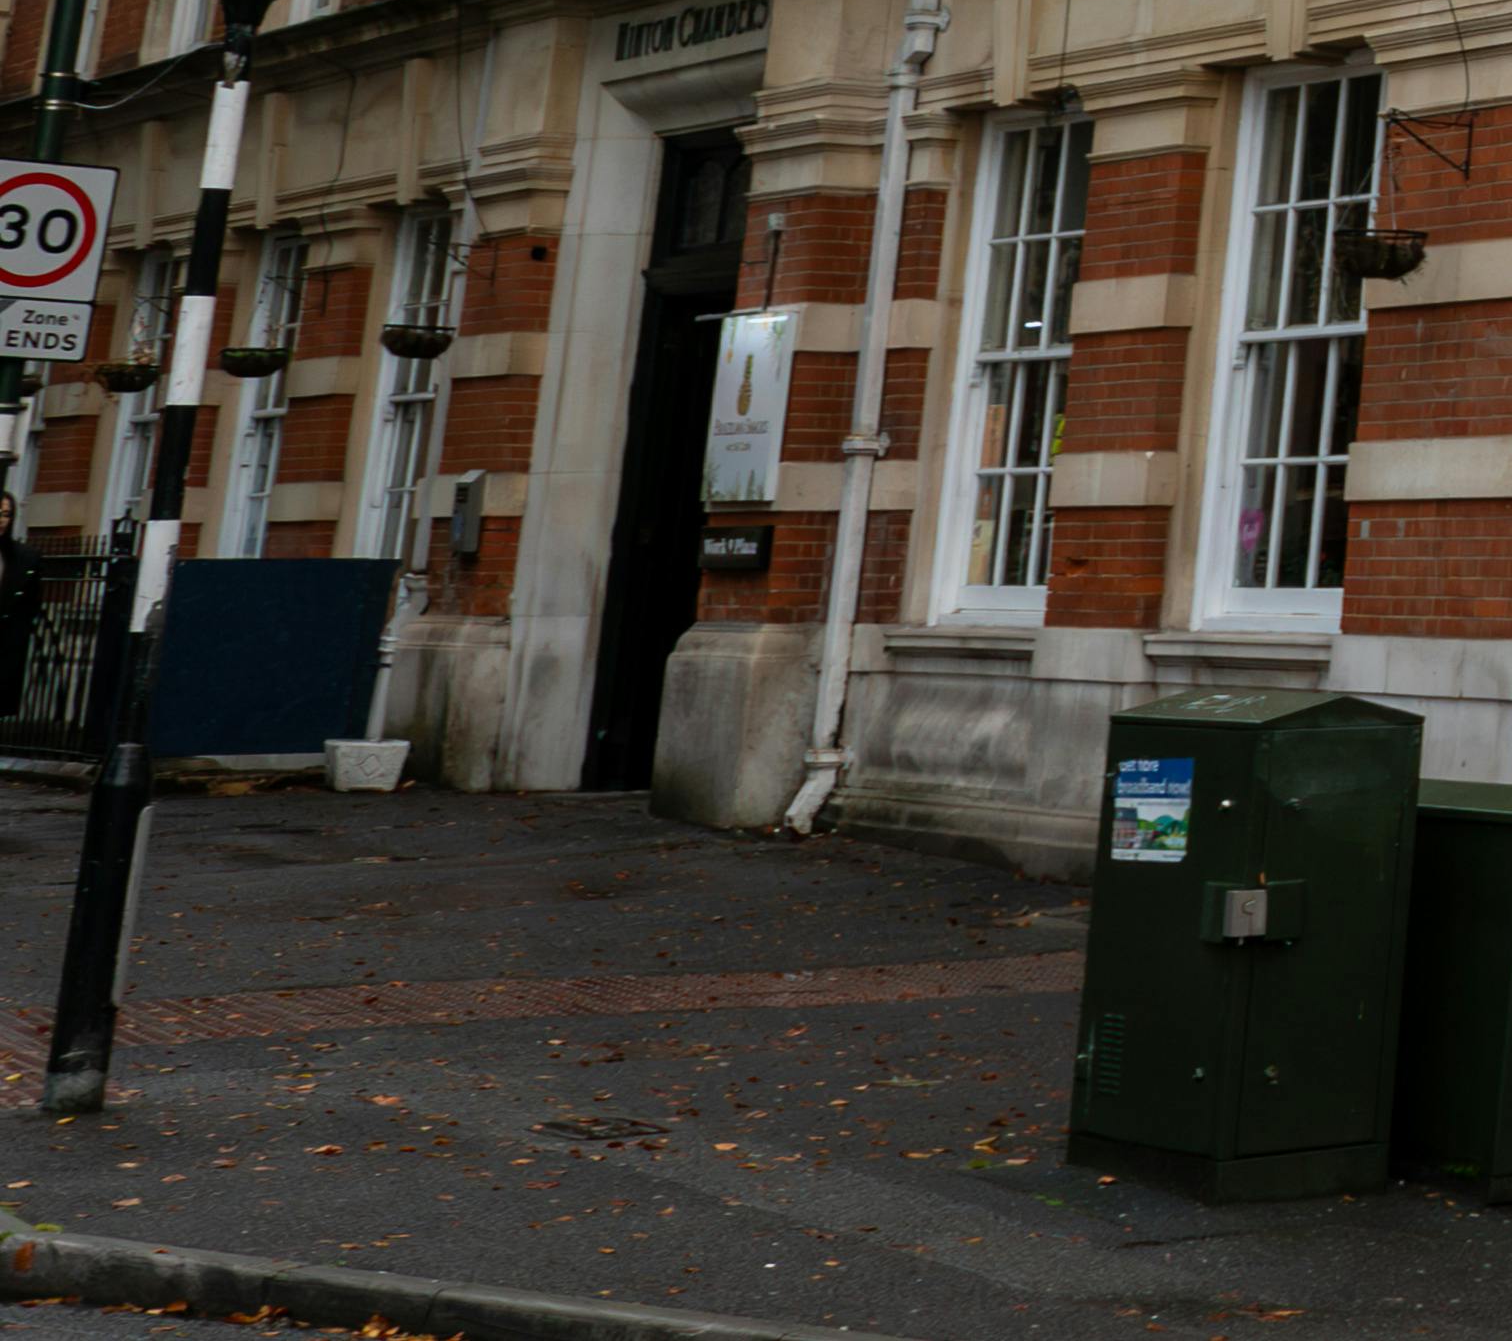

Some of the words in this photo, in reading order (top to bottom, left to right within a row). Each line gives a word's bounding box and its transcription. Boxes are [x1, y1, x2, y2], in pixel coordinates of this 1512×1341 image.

[0, 203, 78, 254] 30
[22, 309, 68, 326] Zone
[4, 329, 78, 351] ENDS
